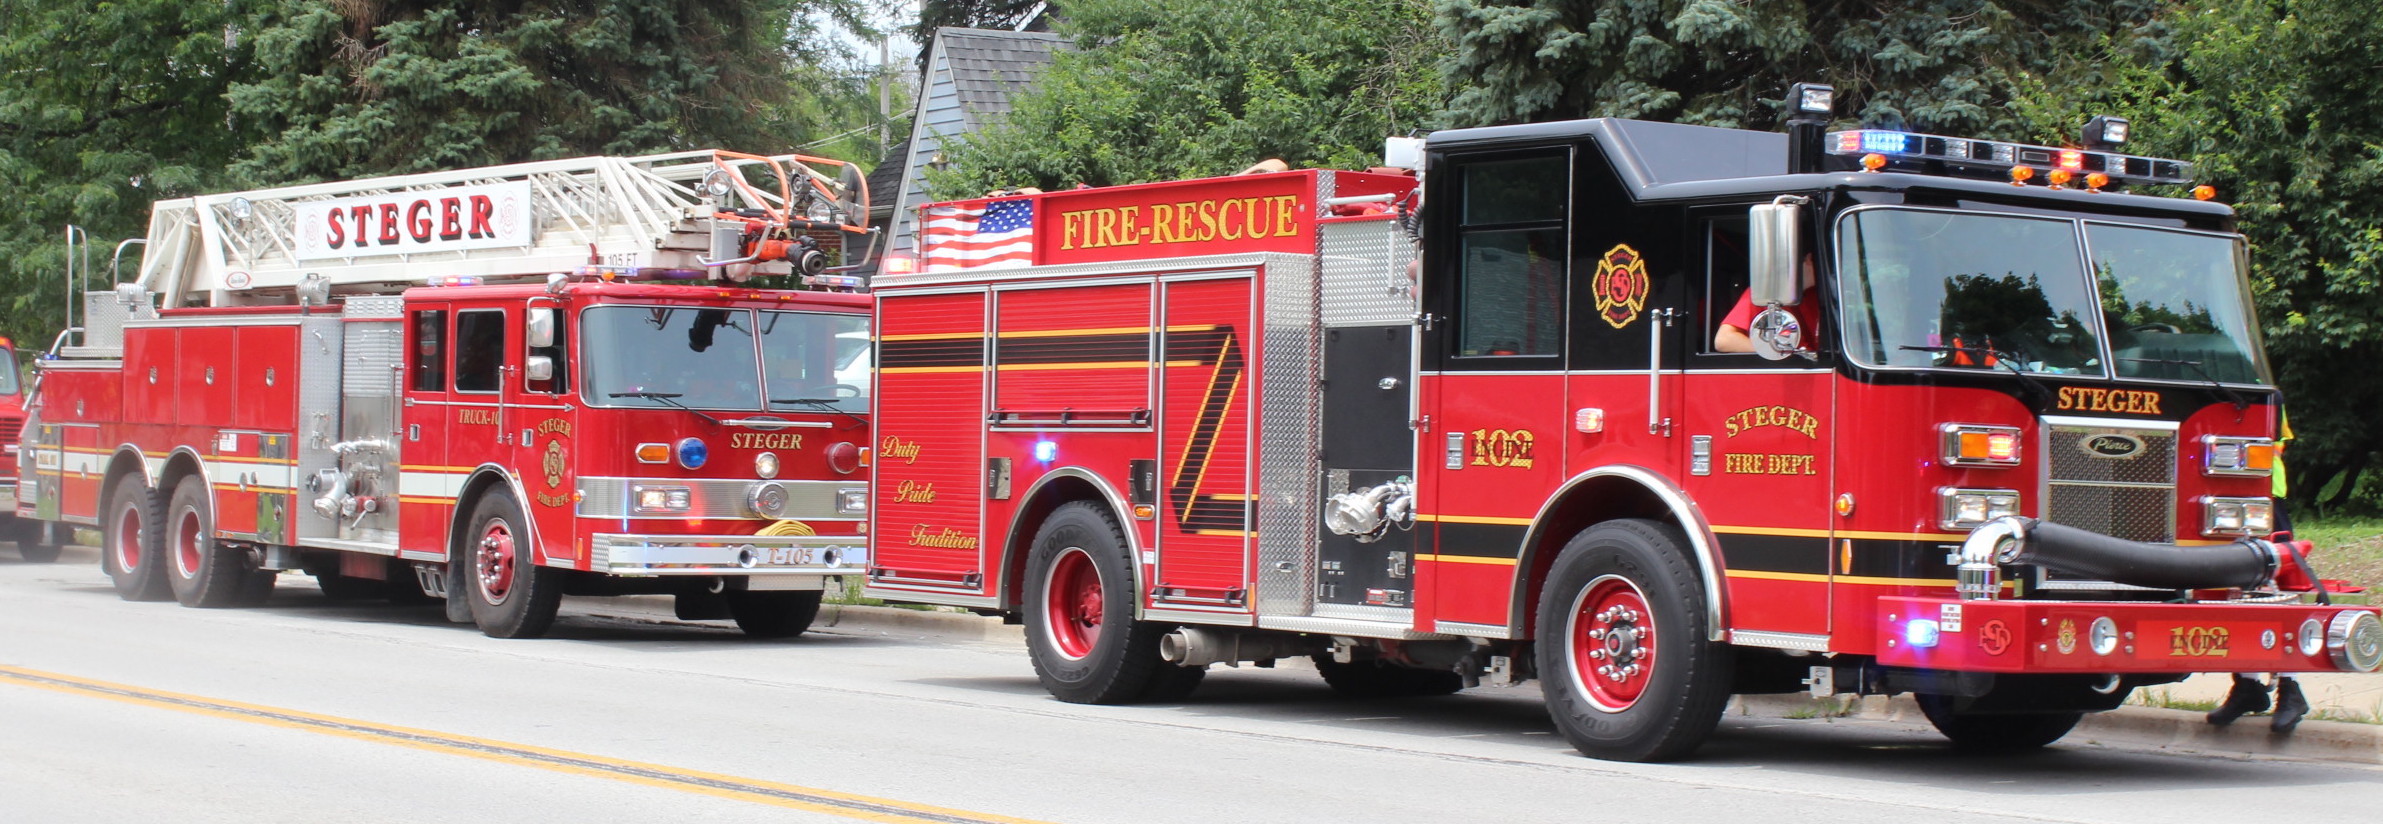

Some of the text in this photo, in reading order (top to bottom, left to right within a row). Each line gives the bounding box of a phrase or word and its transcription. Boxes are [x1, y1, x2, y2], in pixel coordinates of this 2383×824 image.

[326, 194, 496, 250] STEGER
[1060, 195, 1298, 250] FIRE-RESCUE
[608, 252, 638, 266] 105 FT
[2057, 386, 2162, 414] STEGER
[538, 418, 572, 438] STEGER
[1725, 405, 1819, 440] STEGER
[731, 432, 803, 450] STEGER
[880, 435, 921, 465] Duty
[1725, 453, 1817, 475] FIRE DEPT.
[537, 490, 552, 507] FIRE
[893, 479, 937, 503] Pride
[908, 522, 977, 550] Tradition
[767, 548, 814, 566] T-105
